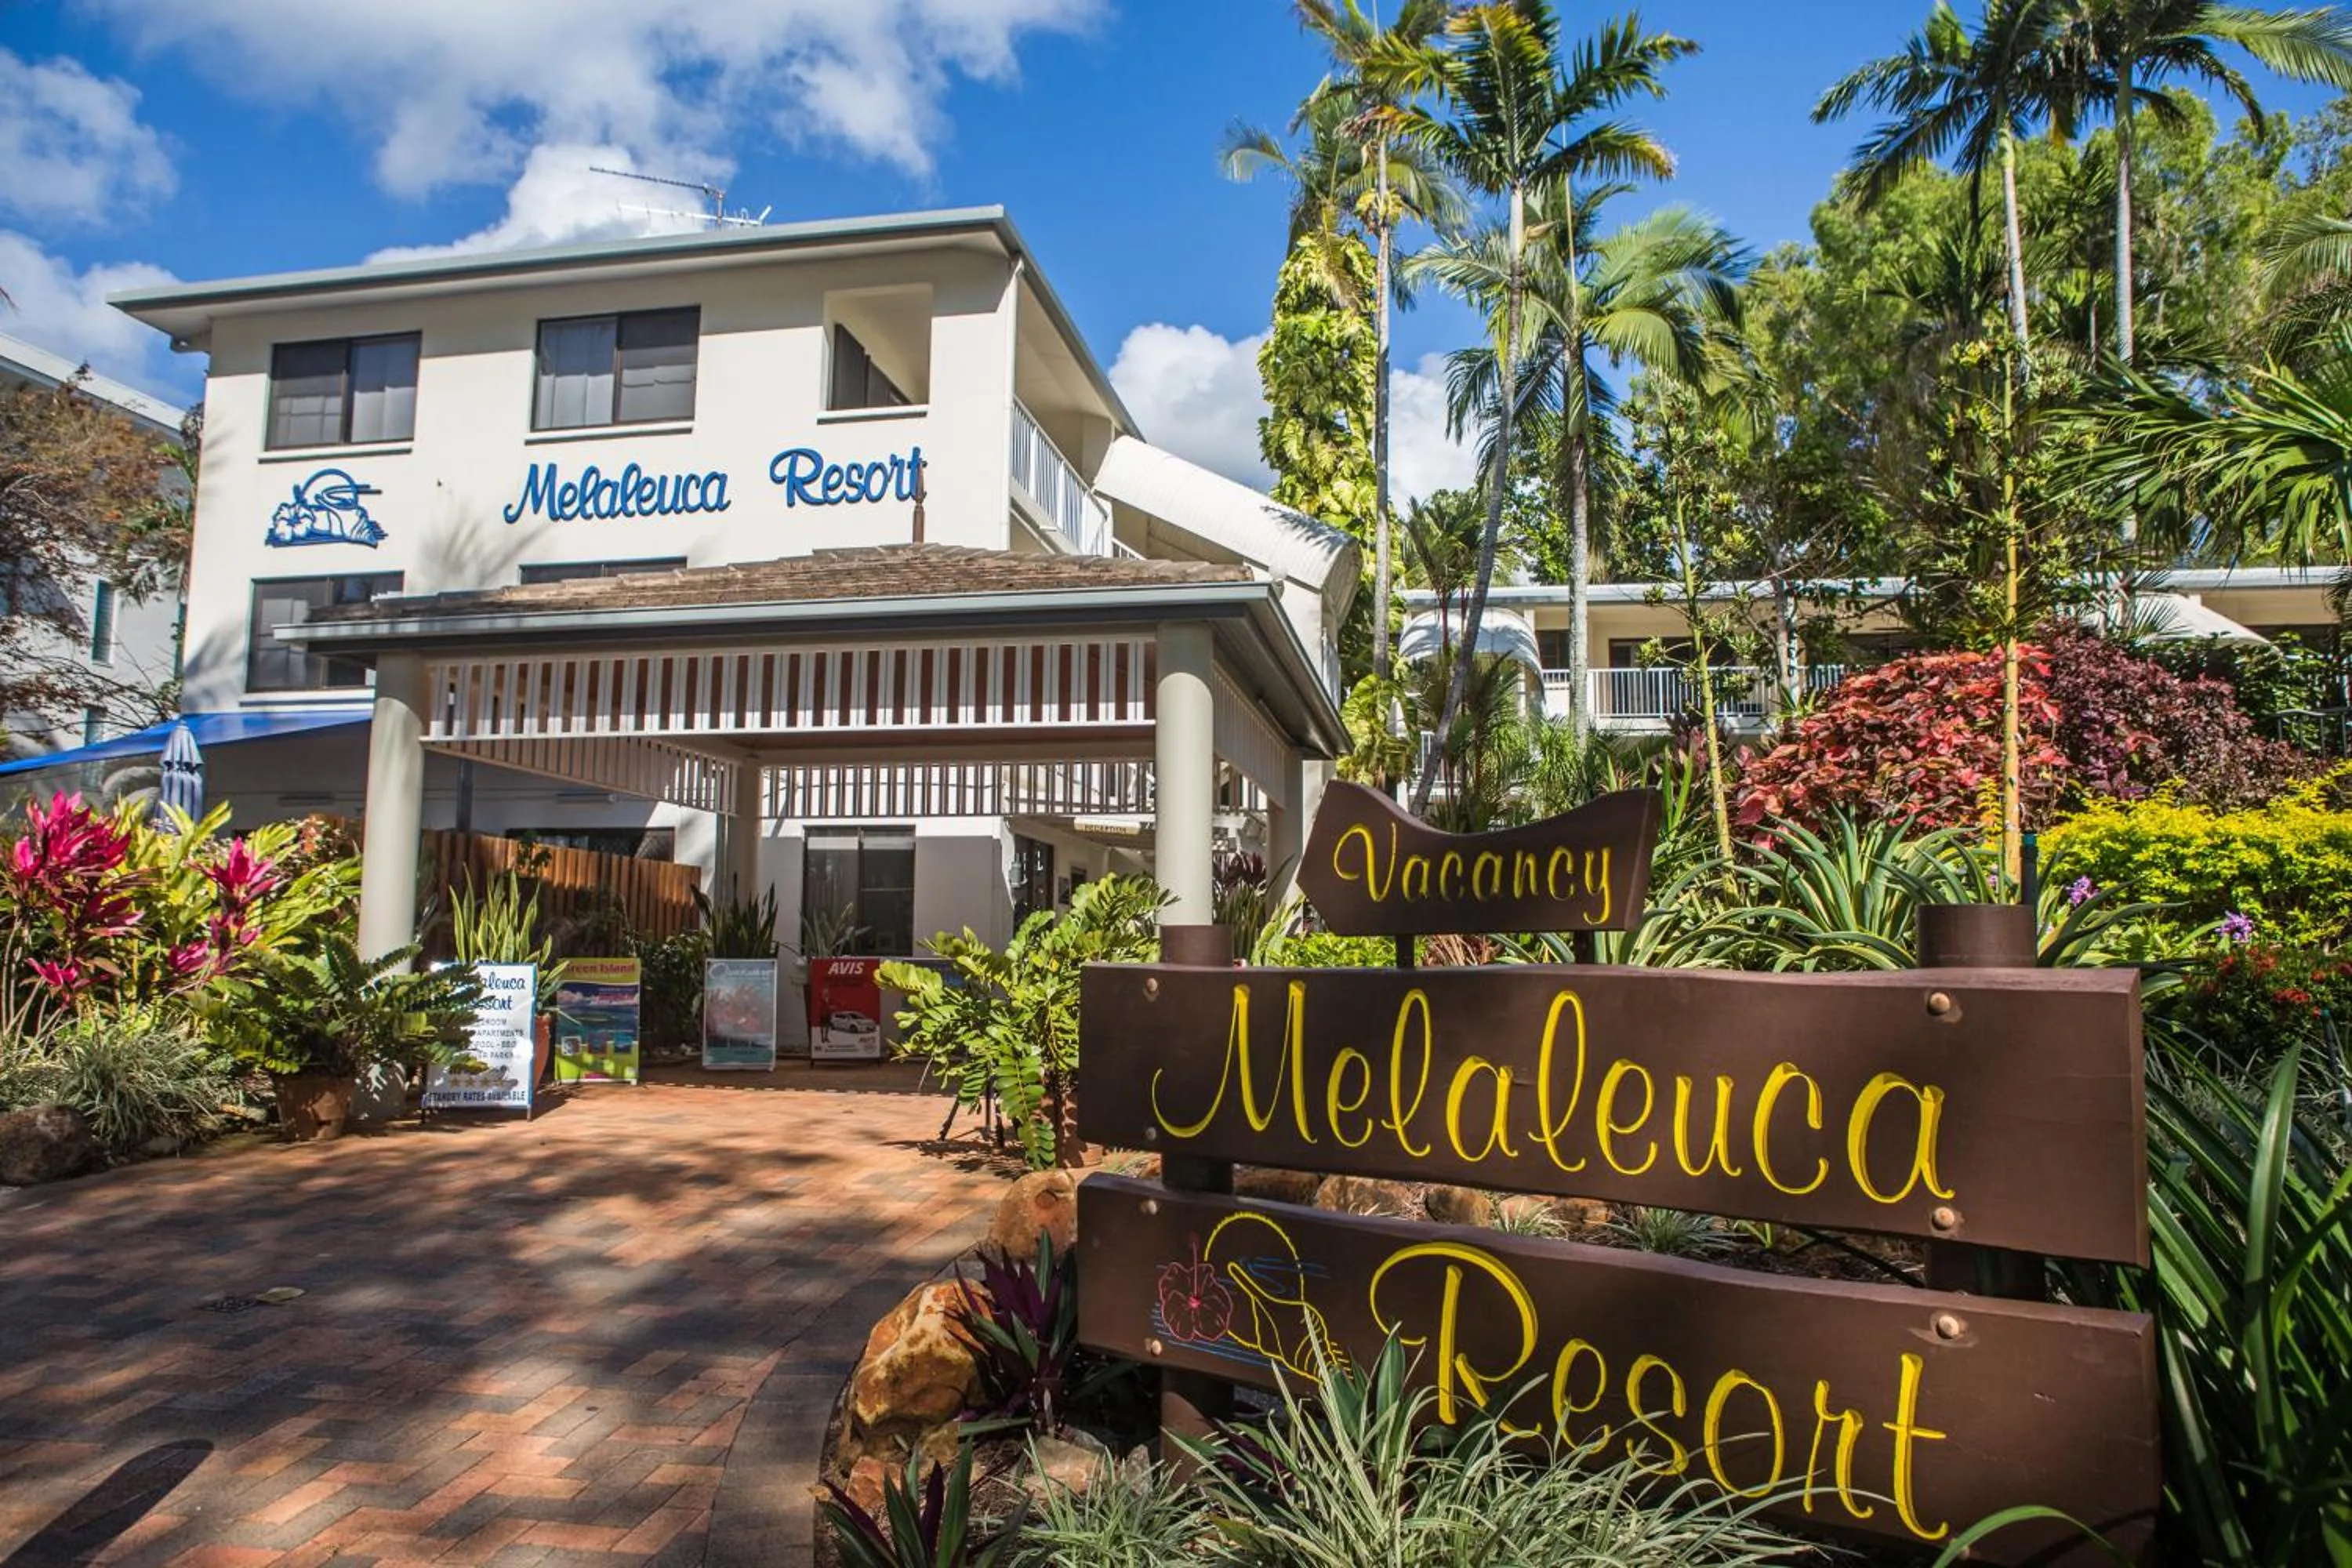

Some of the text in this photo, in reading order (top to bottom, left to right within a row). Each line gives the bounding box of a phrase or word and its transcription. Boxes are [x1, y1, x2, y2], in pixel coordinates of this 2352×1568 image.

[503, 446, 927, 524] Melaleuca Resort
[1334, 824, 1611, 924] Vacancy
[828, 961, 865, 975] AVIS
[1152, 980, 1955, 1204] Melaleuca
[1370, 1241, 1947, 1540] Resort
